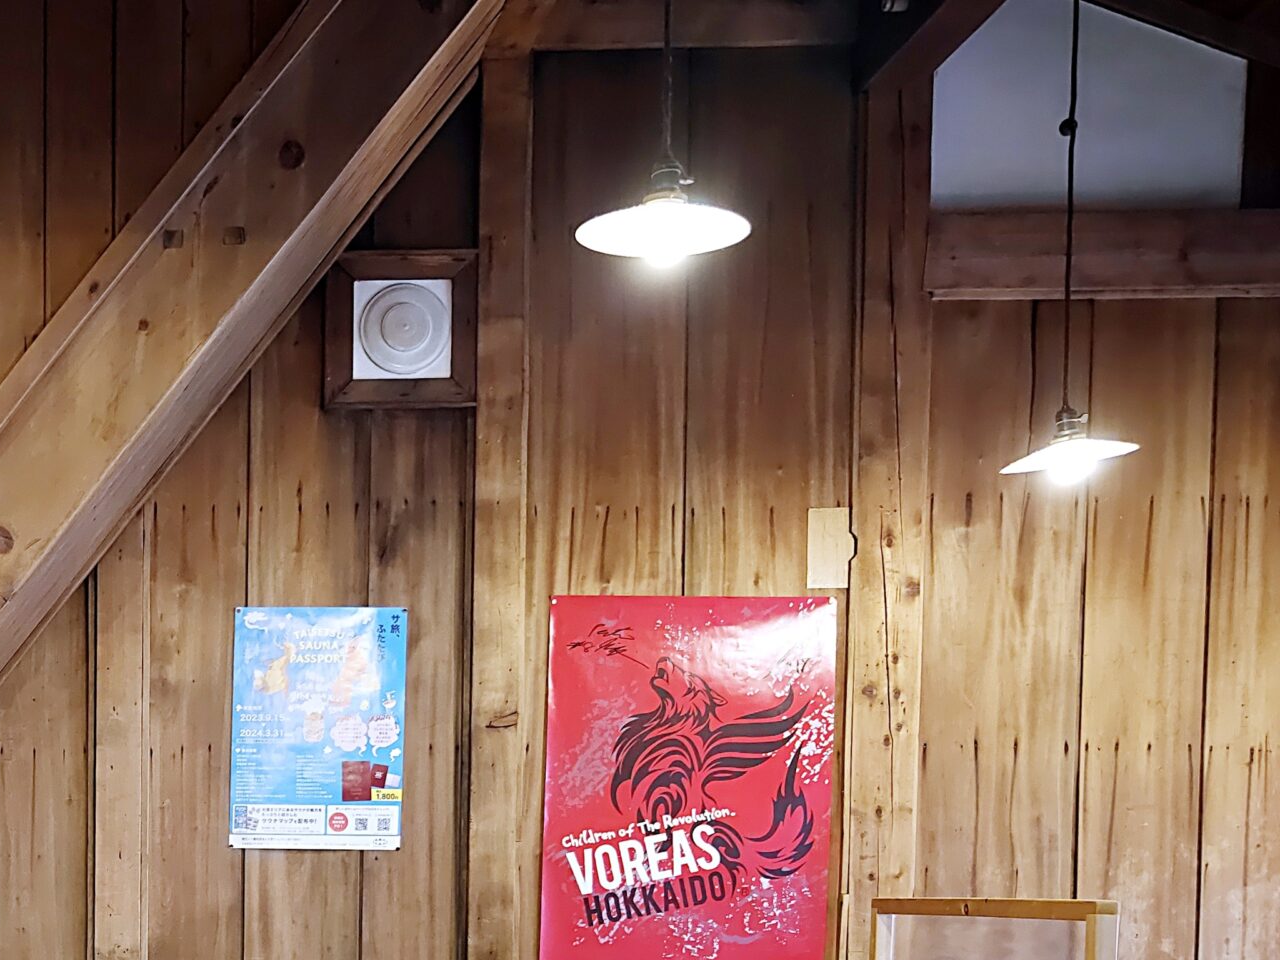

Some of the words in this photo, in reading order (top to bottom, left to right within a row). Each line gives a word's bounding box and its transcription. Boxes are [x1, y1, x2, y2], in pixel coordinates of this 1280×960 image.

[289, 654, 347, 664] PASSPORT
[299, 641, 338, 650] SAUNA
[561, 829, 616, 848] Children
[618, 823, 635, 838] of
[637, 820, 661, 834] The
[662, 807, 737, 829] Revolution.
[566, 824, 721, 895] VOREAS
[583, 871, 726, 927] HOKKAIDO
